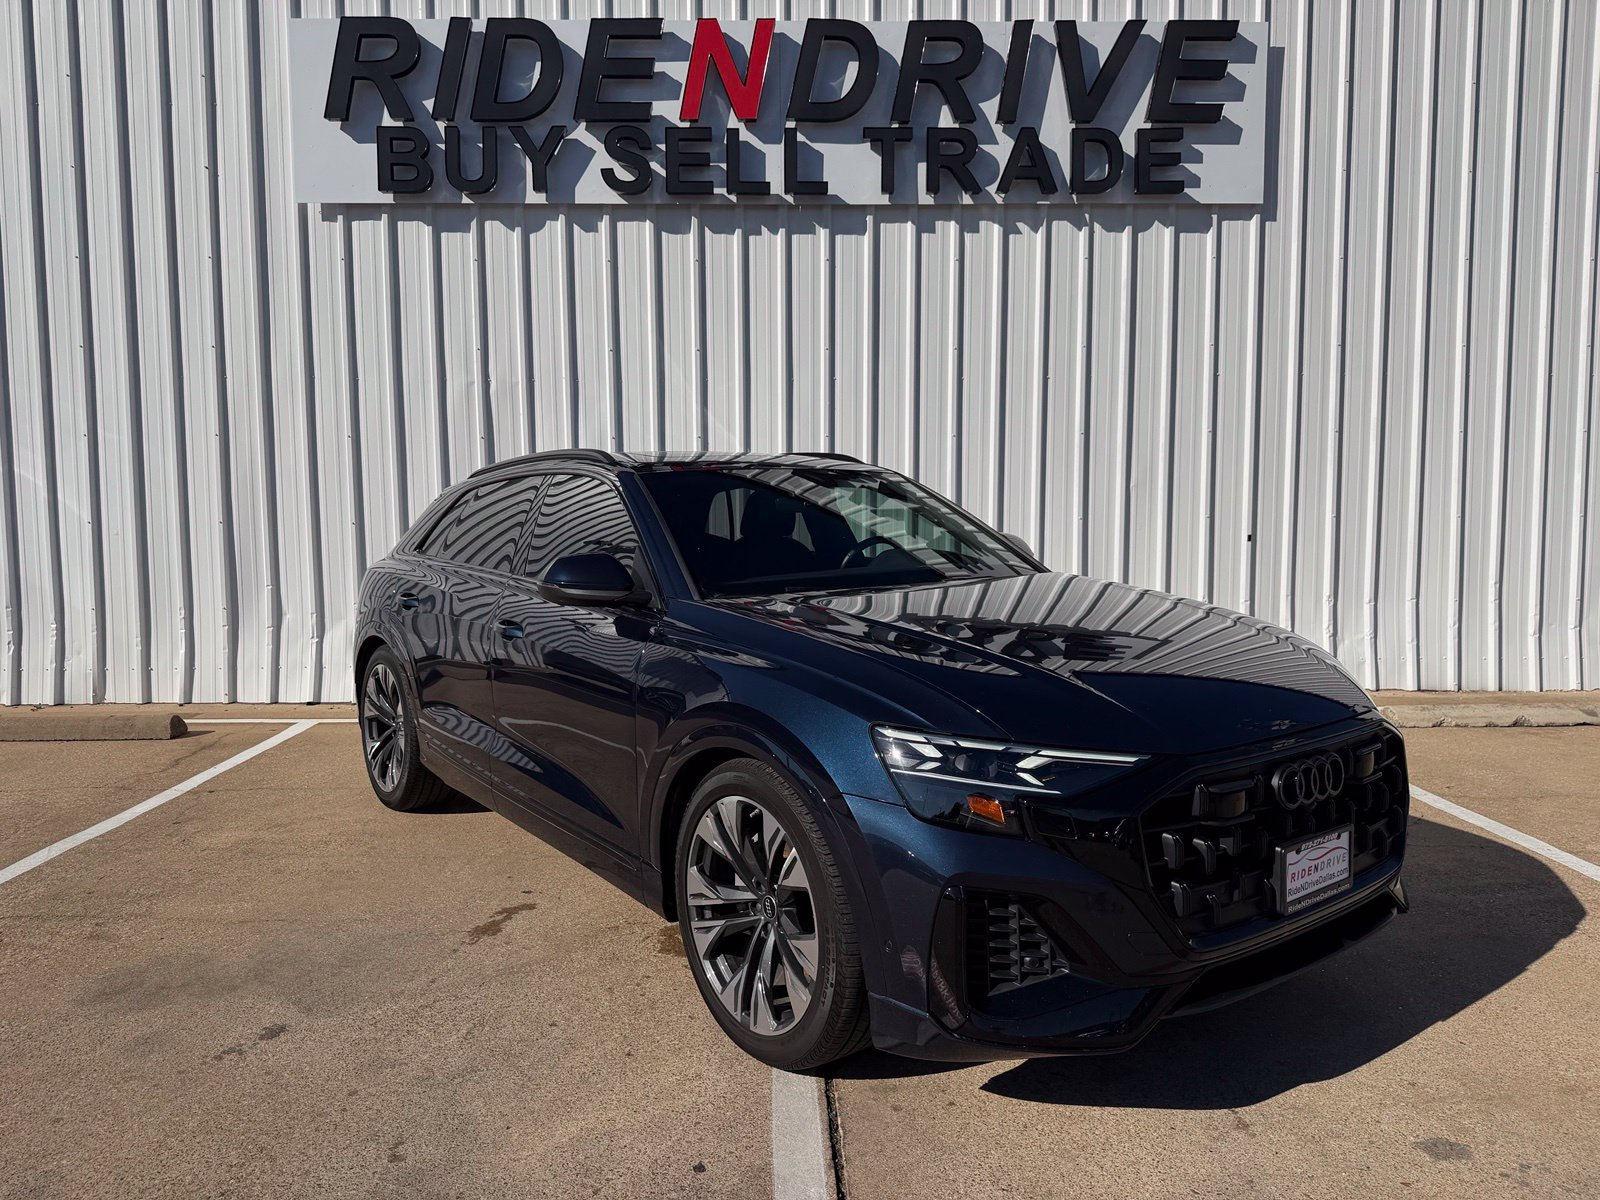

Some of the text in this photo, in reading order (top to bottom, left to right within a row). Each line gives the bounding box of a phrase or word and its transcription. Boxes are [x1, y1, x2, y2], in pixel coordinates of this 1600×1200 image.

[324, 16, 1240, 123] RIDENDRIVE
[376, 125, 1185, 196] BUY SELL TRADE
[1287, 867, 1349, 897] RideNDriveDallas.com
[1290, 852, 1347, 883] RIDENDRIVE
